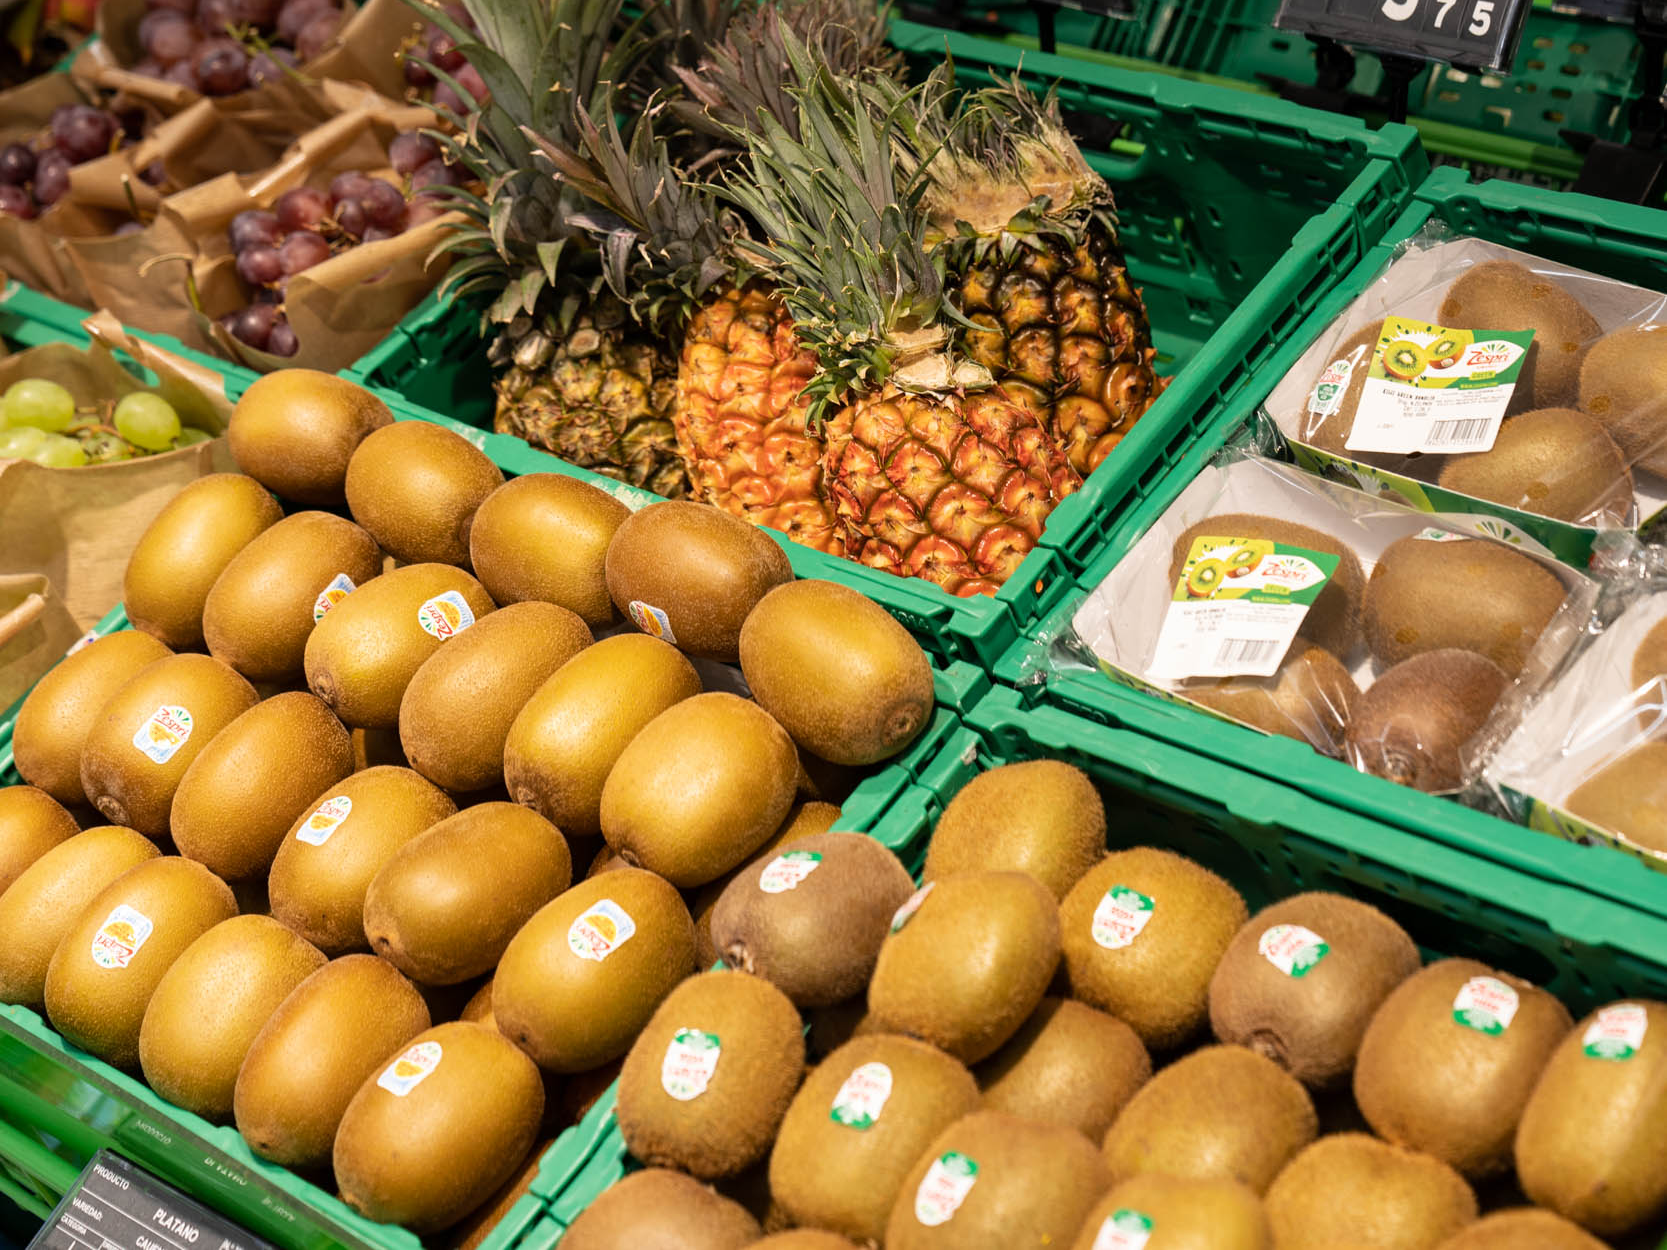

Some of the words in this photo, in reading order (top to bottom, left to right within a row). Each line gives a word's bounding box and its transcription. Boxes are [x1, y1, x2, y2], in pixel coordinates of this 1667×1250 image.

[1467, 351, 1510, 366] Zespri
[423, 603, 454, 640] Zespri
[153, 707, 188, 737] Zespri
[93, 1163, 130, 1191] PRODUCTO
[152, 1208, 200, 1244] PLATANO
